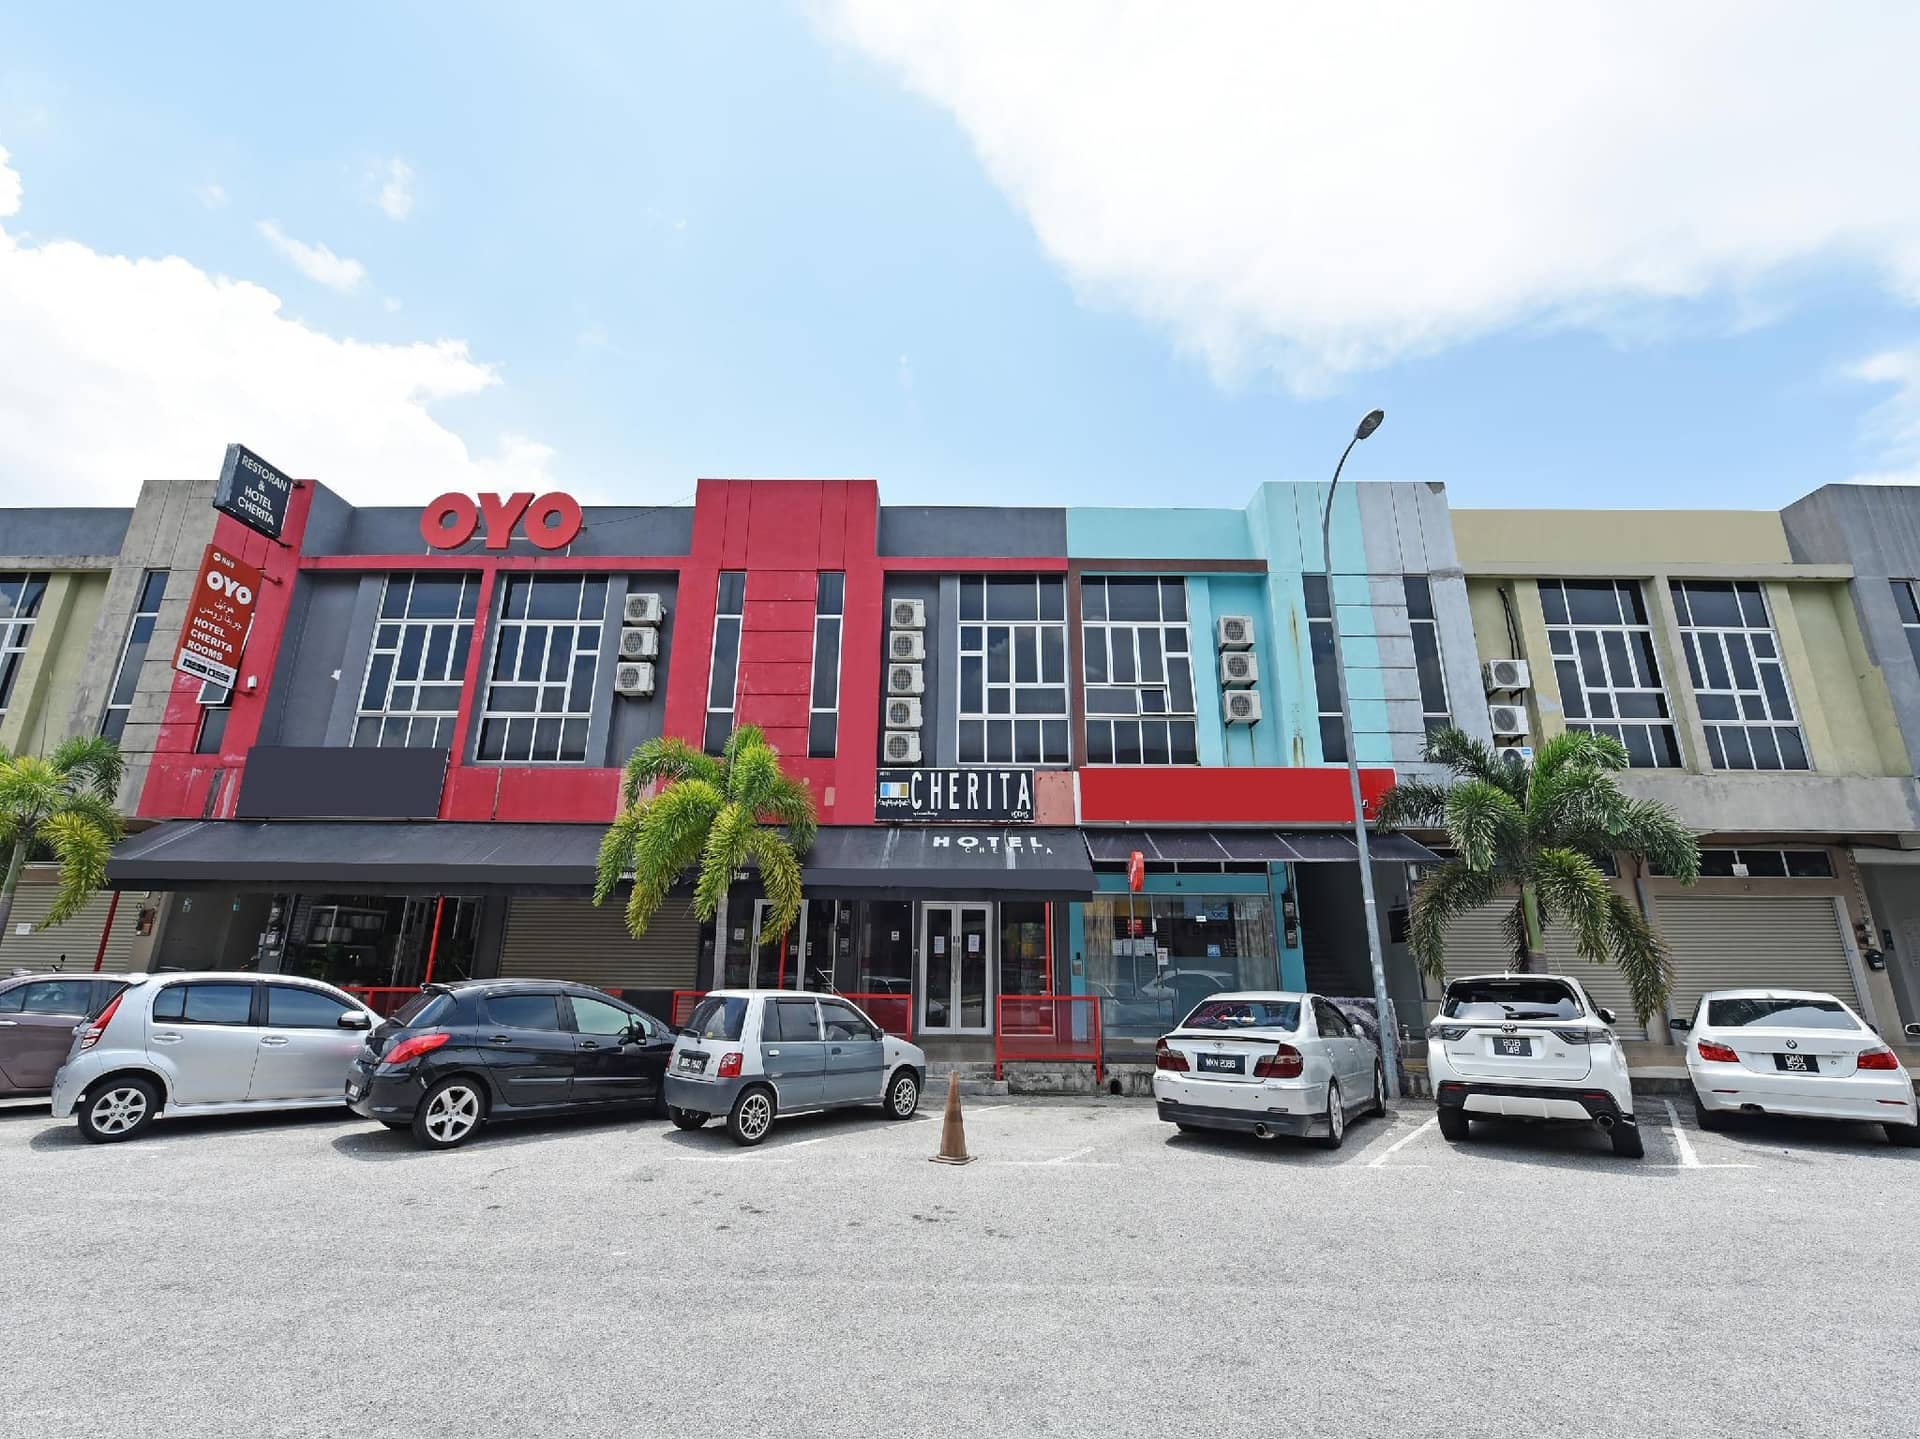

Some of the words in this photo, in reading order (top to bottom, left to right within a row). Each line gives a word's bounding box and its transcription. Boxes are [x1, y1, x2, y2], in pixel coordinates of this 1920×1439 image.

[241, 455, 288, 492] RESTORAN
[244, 485, 272, 511] HOTEL
[258, 481, 265, 492] &
[237, 496, 275, 526] CHERITA
[420, 492, 583, 550] OYO
[206, 570, 252, 605] OYO
[193, 616, 225, 637] HOTEL
[186, 640, 223, 661] ROOMS
[190, 628, 233, 653] CHERITA
[910, 771, 1031, 810] CHERITA
[933, 836, 1042, 848] HOTEL
[964, 847, 1054, 855] CHEITA
[1787, 1062, 1808, 1071] 523
